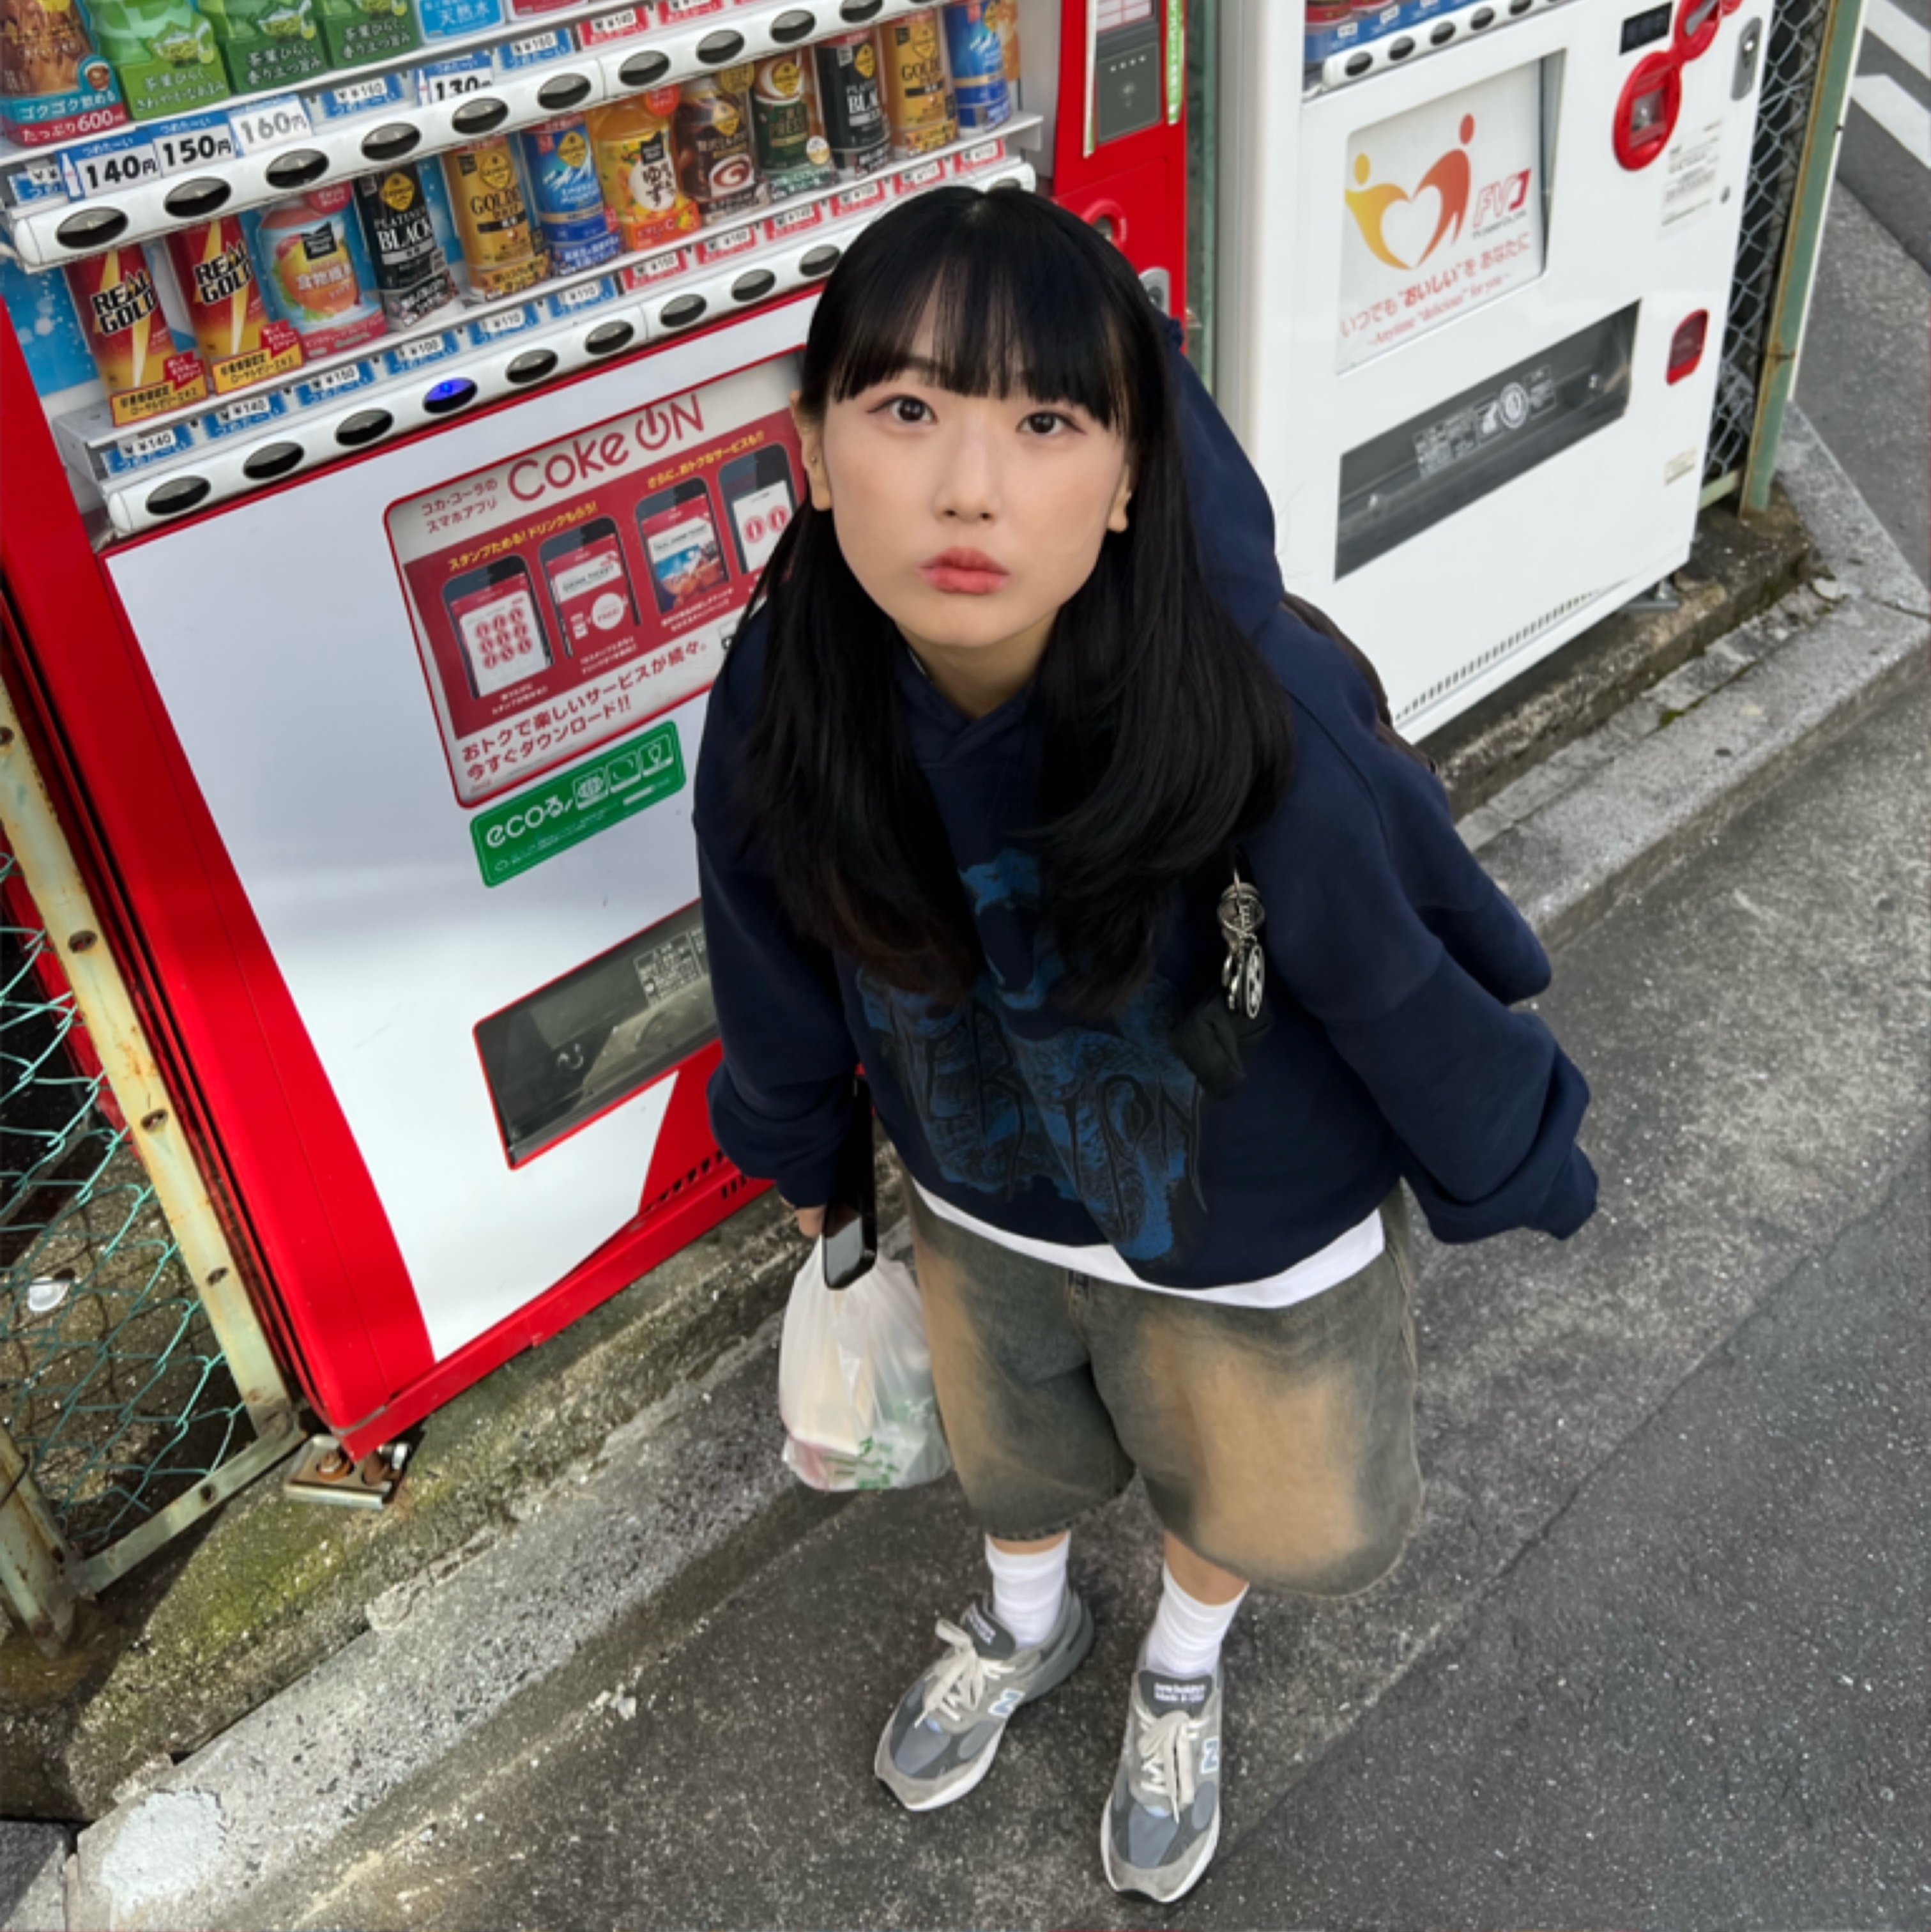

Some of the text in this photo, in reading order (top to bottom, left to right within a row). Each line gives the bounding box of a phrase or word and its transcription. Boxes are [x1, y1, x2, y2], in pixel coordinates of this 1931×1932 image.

[240, 112, 307, 143] 160円
[163, 135, 231, 167] 150円
[86, 155, 157, 188] 140円
[194, 239, 250, 286] REAL
[91, 268, 150, 316] REAL
[201, 263, 253, 305] GOLD
[99, 289, 158, 335] GOLD
[507, 394, 704, 501] Coke ON
[427, 497, 497, 534] スマホアプリ
[988, 1688, 1025, 1717] N
